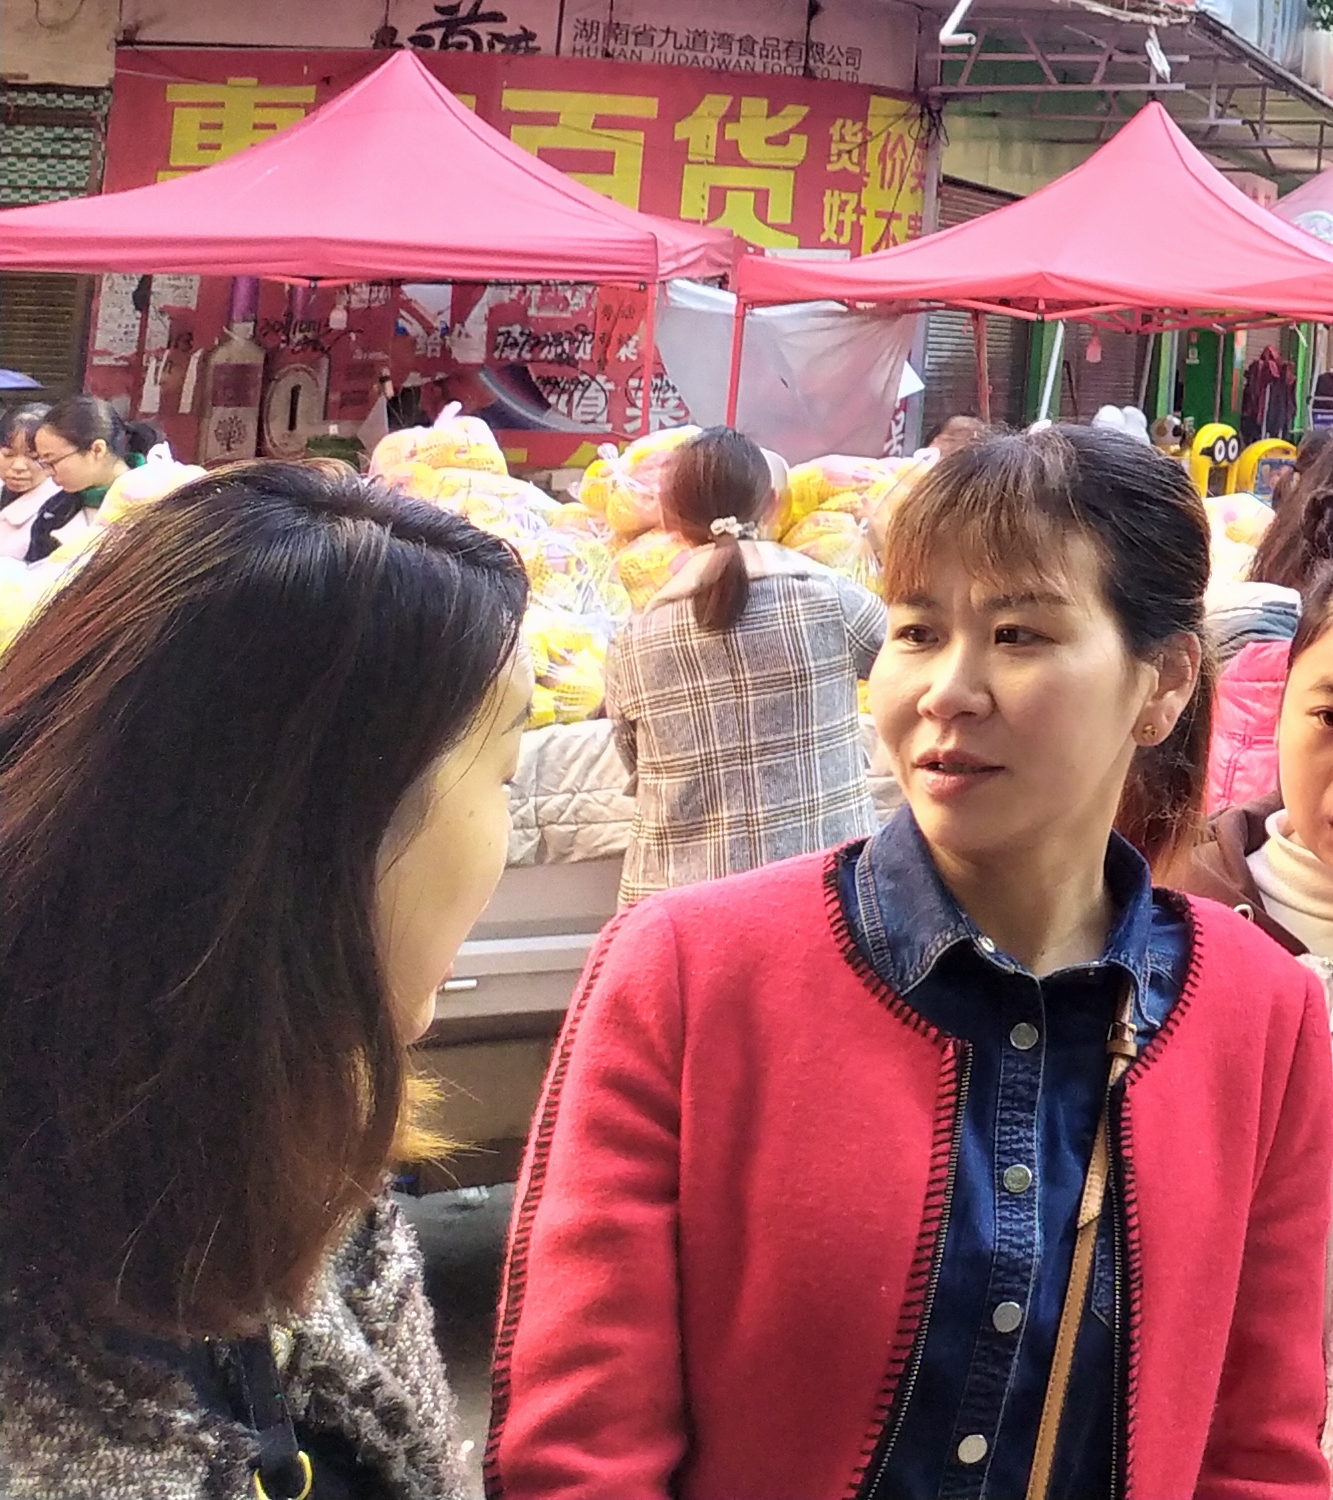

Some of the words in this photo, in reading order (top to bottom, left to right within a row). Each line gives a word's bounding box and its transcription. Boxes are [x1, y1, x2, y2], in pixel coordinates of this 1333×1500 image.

[573, 17, 863, 71] 湖南省九道湾食品有限公司
